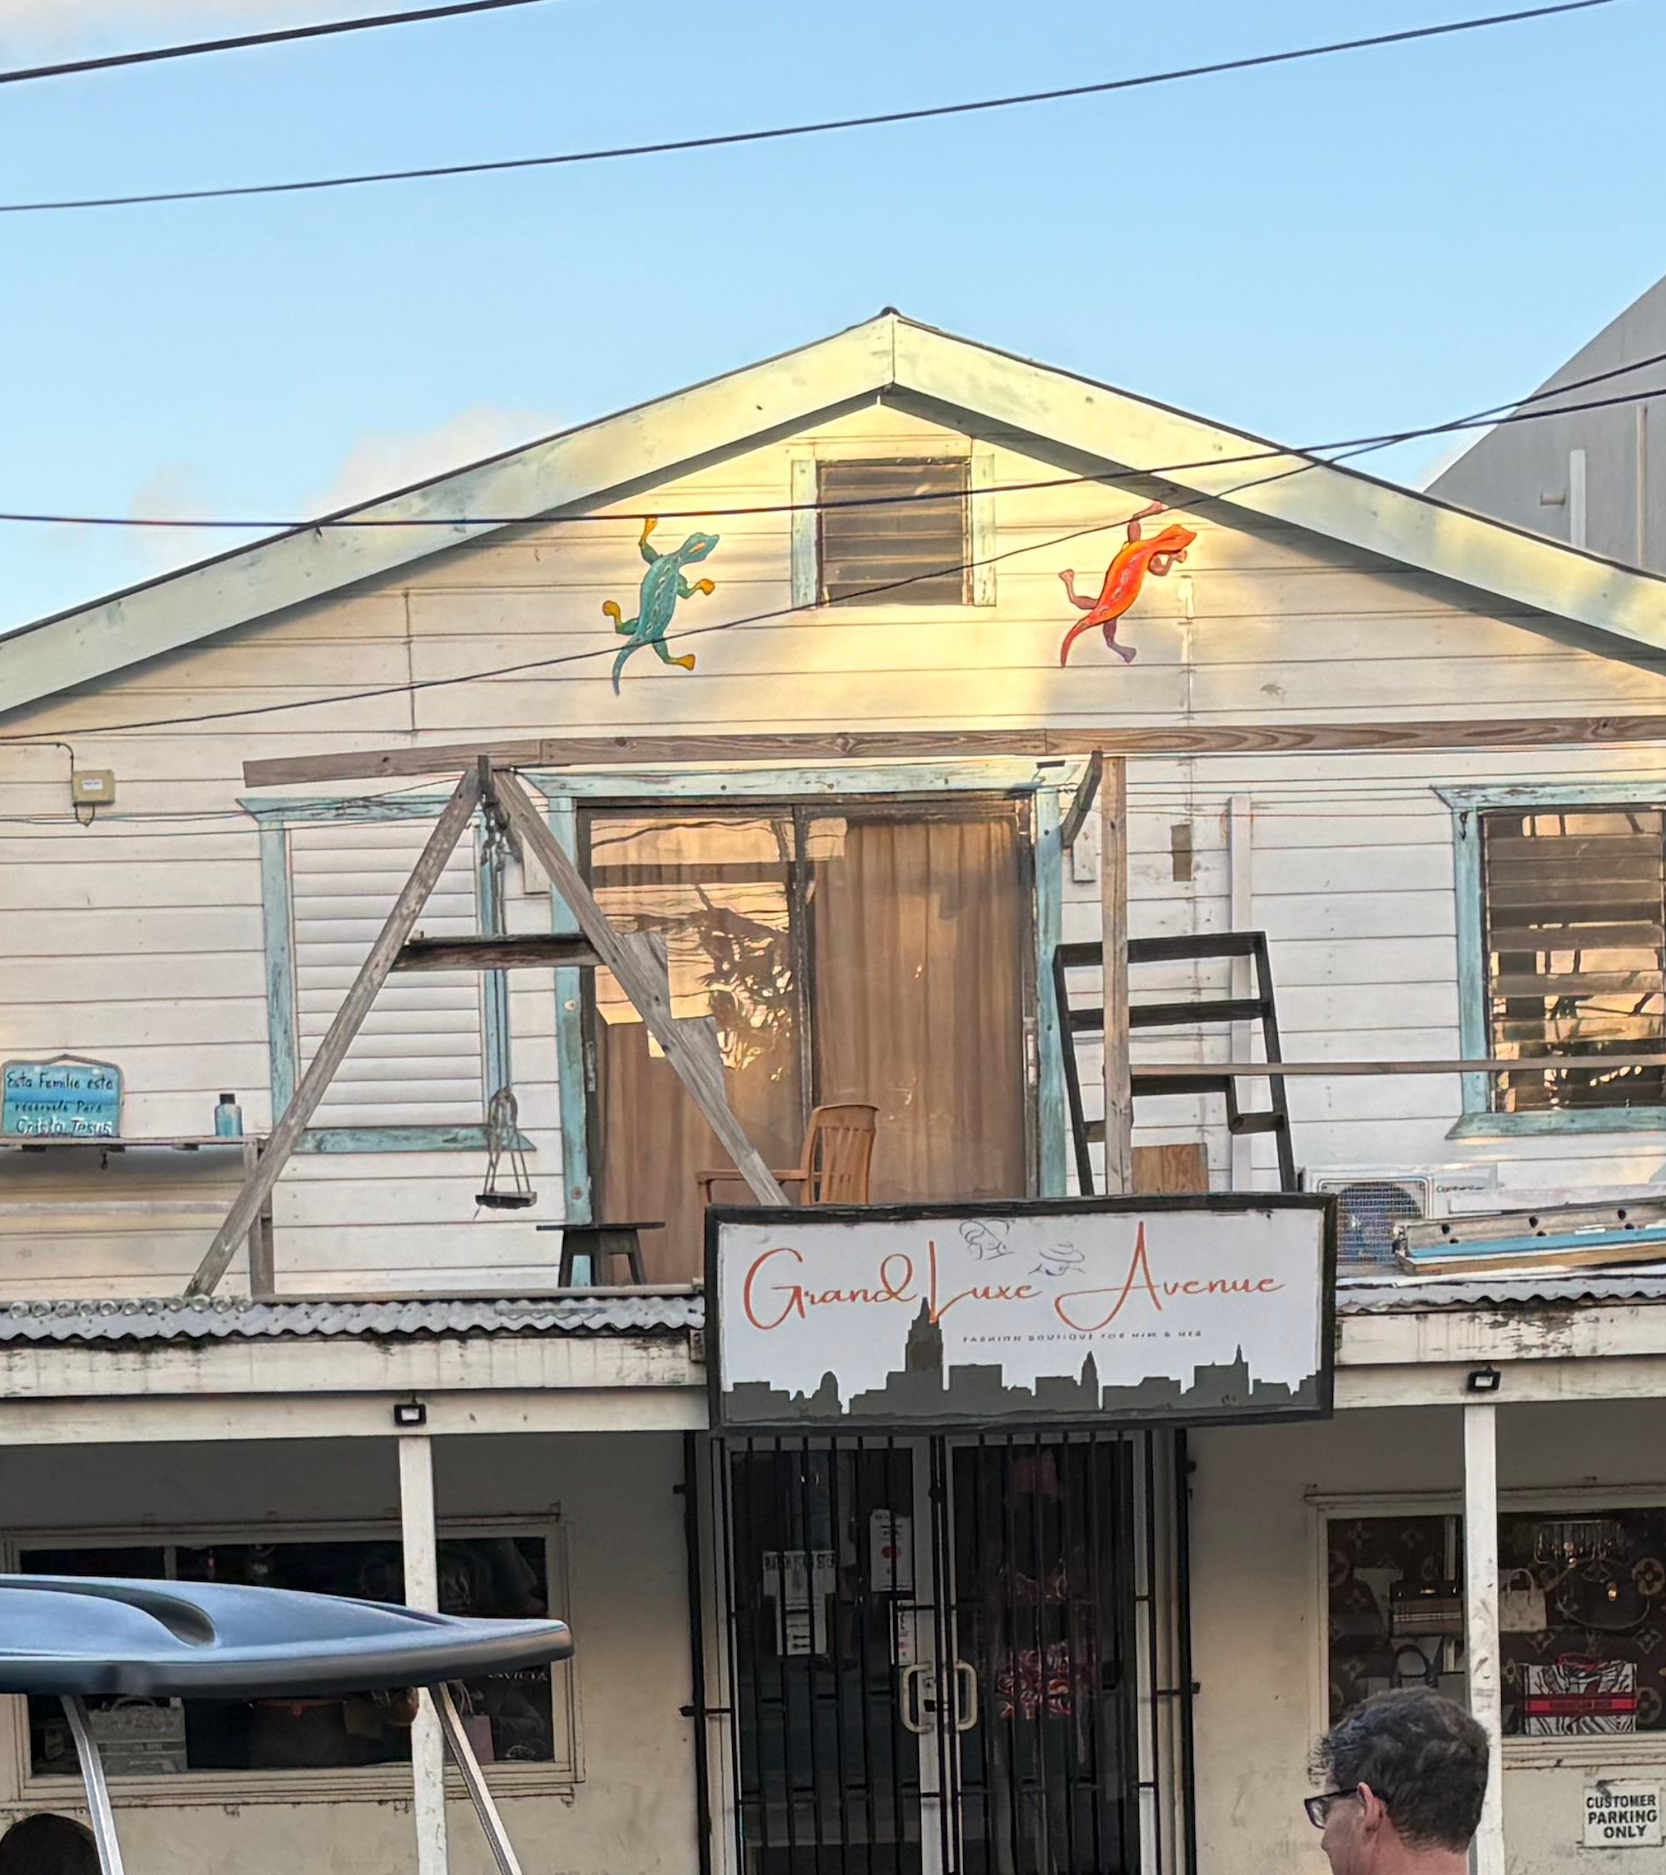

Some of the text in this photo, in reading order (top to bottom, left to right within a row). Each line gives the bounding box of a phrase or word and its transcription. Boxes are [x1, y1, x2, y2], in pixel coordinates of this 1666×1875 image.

[742, 1220, 1286, 1333] Grand Luxe Avenue
[1586, 1794, 1656, 1809] CUSTOMER
[1588, 1809, 1658, 1825] PARKING
[1603, 1824, 1647, 1839] ONLY
